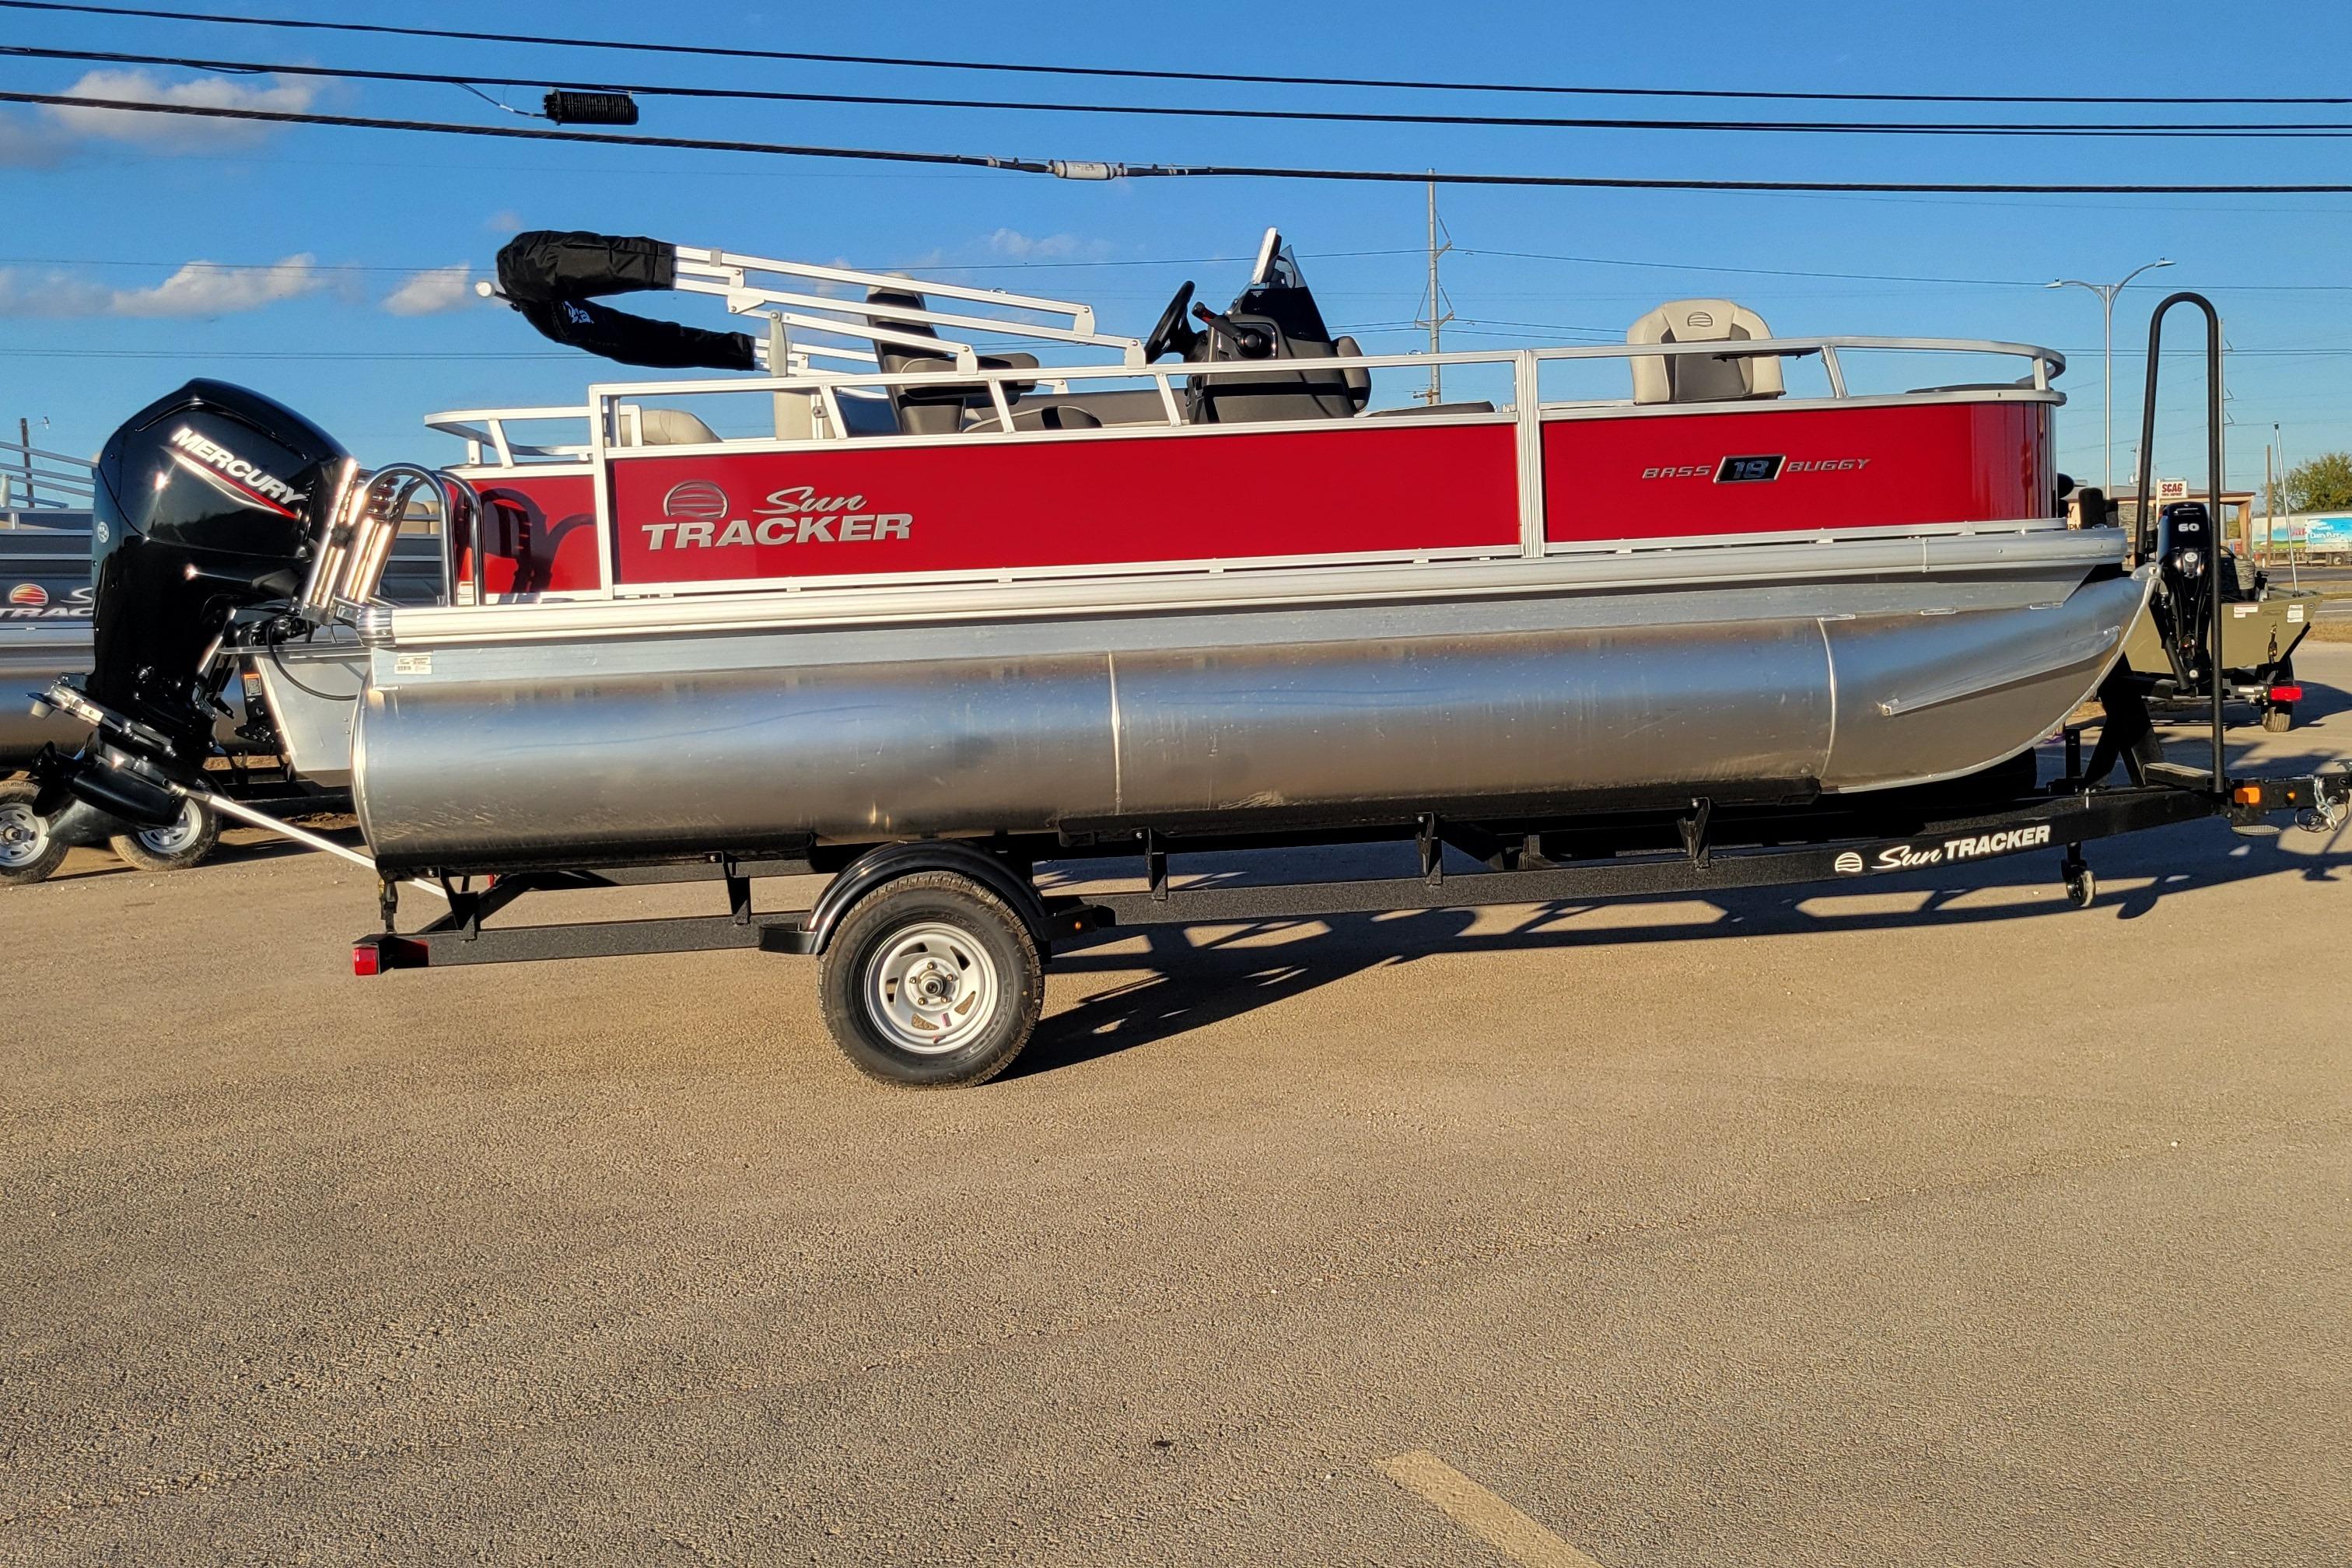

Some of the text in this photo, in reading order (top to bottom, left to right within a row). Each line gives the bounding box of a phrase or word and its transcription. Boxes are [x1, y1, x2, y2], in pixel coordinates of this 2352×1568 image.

[172, 427, 310, 505] MERCURY
[1642, 458, 1871, 480] BASS 18 BUGGY
[2161, 482, 2183, 493] SCAG
[752, 486, 867, 515] Sun
[641, 513, 914, 551] TRACKER
[2178, 523, 2200, 532] 60
[0, 607, 93, 618] TRAC
[1870, 824, 2051, 870] Sun TRACKER
